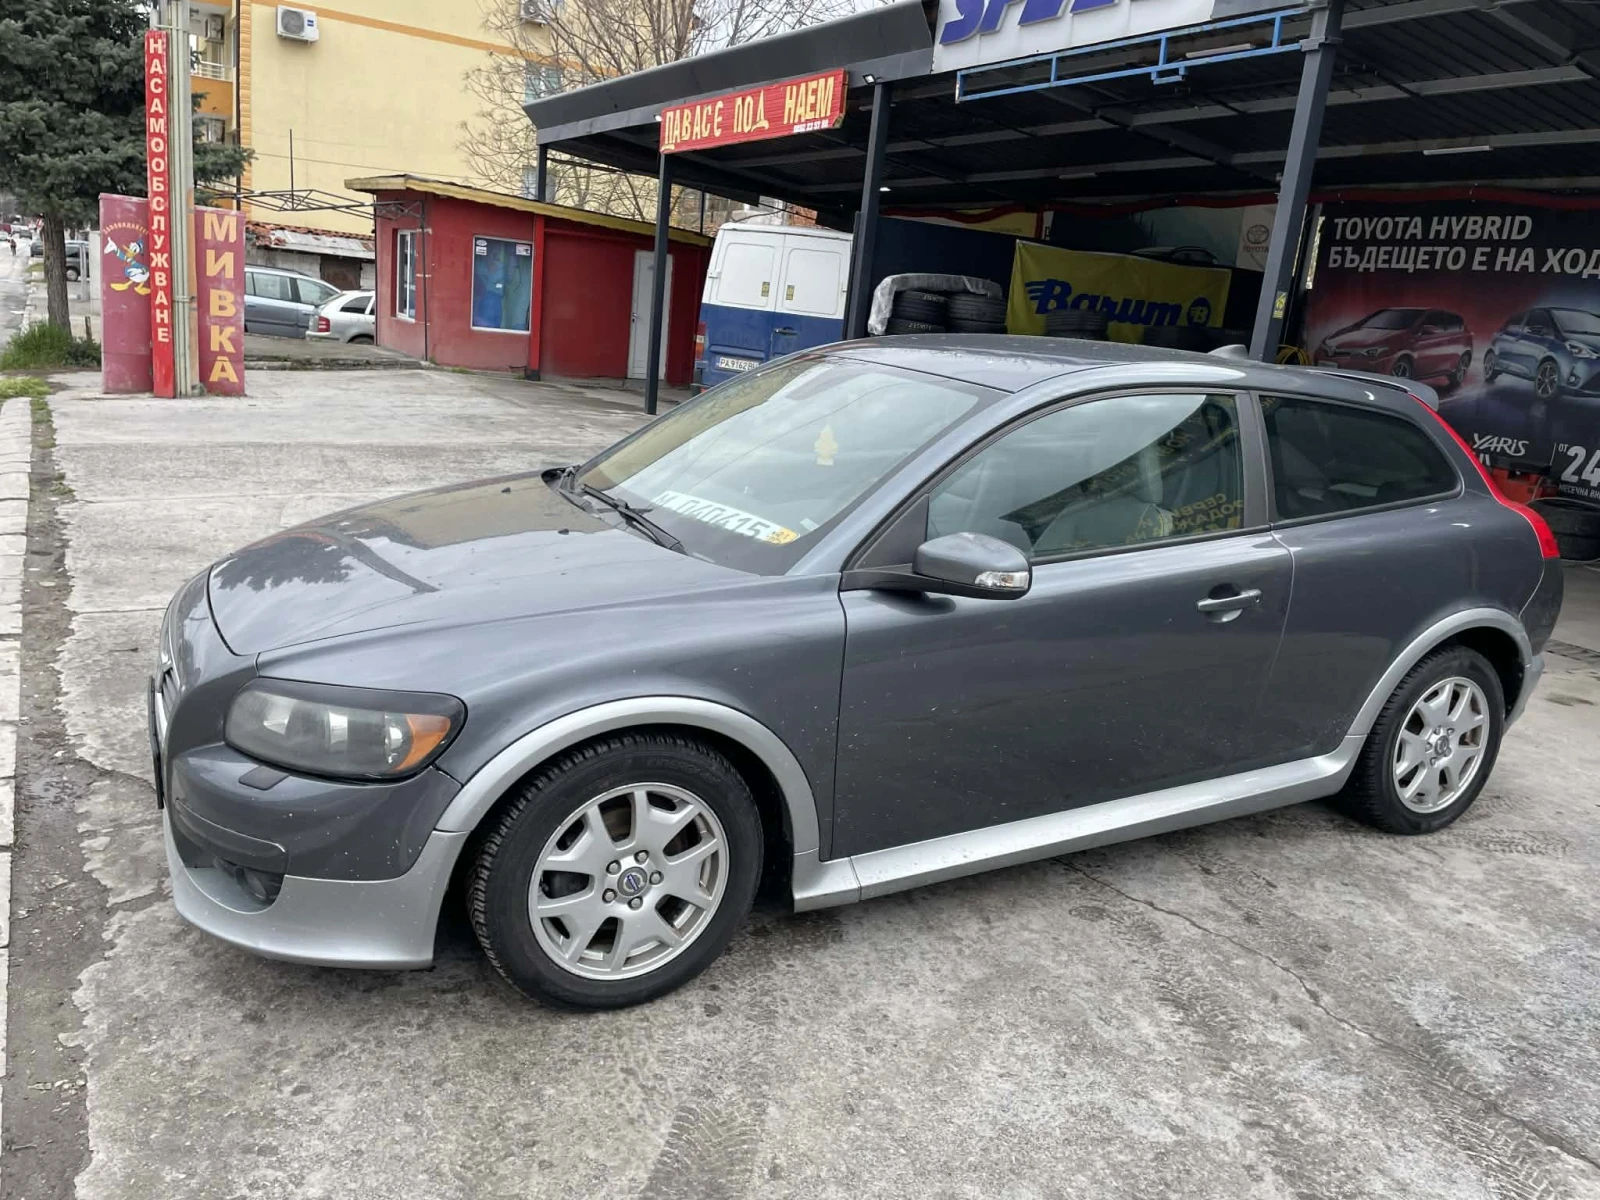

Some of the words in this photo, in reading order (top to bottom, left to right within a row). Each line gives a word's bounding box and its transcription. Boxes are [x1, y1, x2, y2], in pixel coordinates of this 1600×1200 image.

[733, 89, 769, 133] ПОД
[783, 76, 834, 124] НАЕМ
[1334, 217, 1423, 240] TOYOTA
[1429, 215, 1532, 240] HYBRID
[1328, 246, 1466, 273] БЪДЕЩЕТО
[1472, 247, 1491, 271] Е
[1494, 248, 1535, 272] НА
[1541, 247, 1600, 280] ХОД
[203, 212, 239, 383] МИВКА
[1027, 279, 1182, 326] Barum
[1561, 446, 1600, 487] 24
